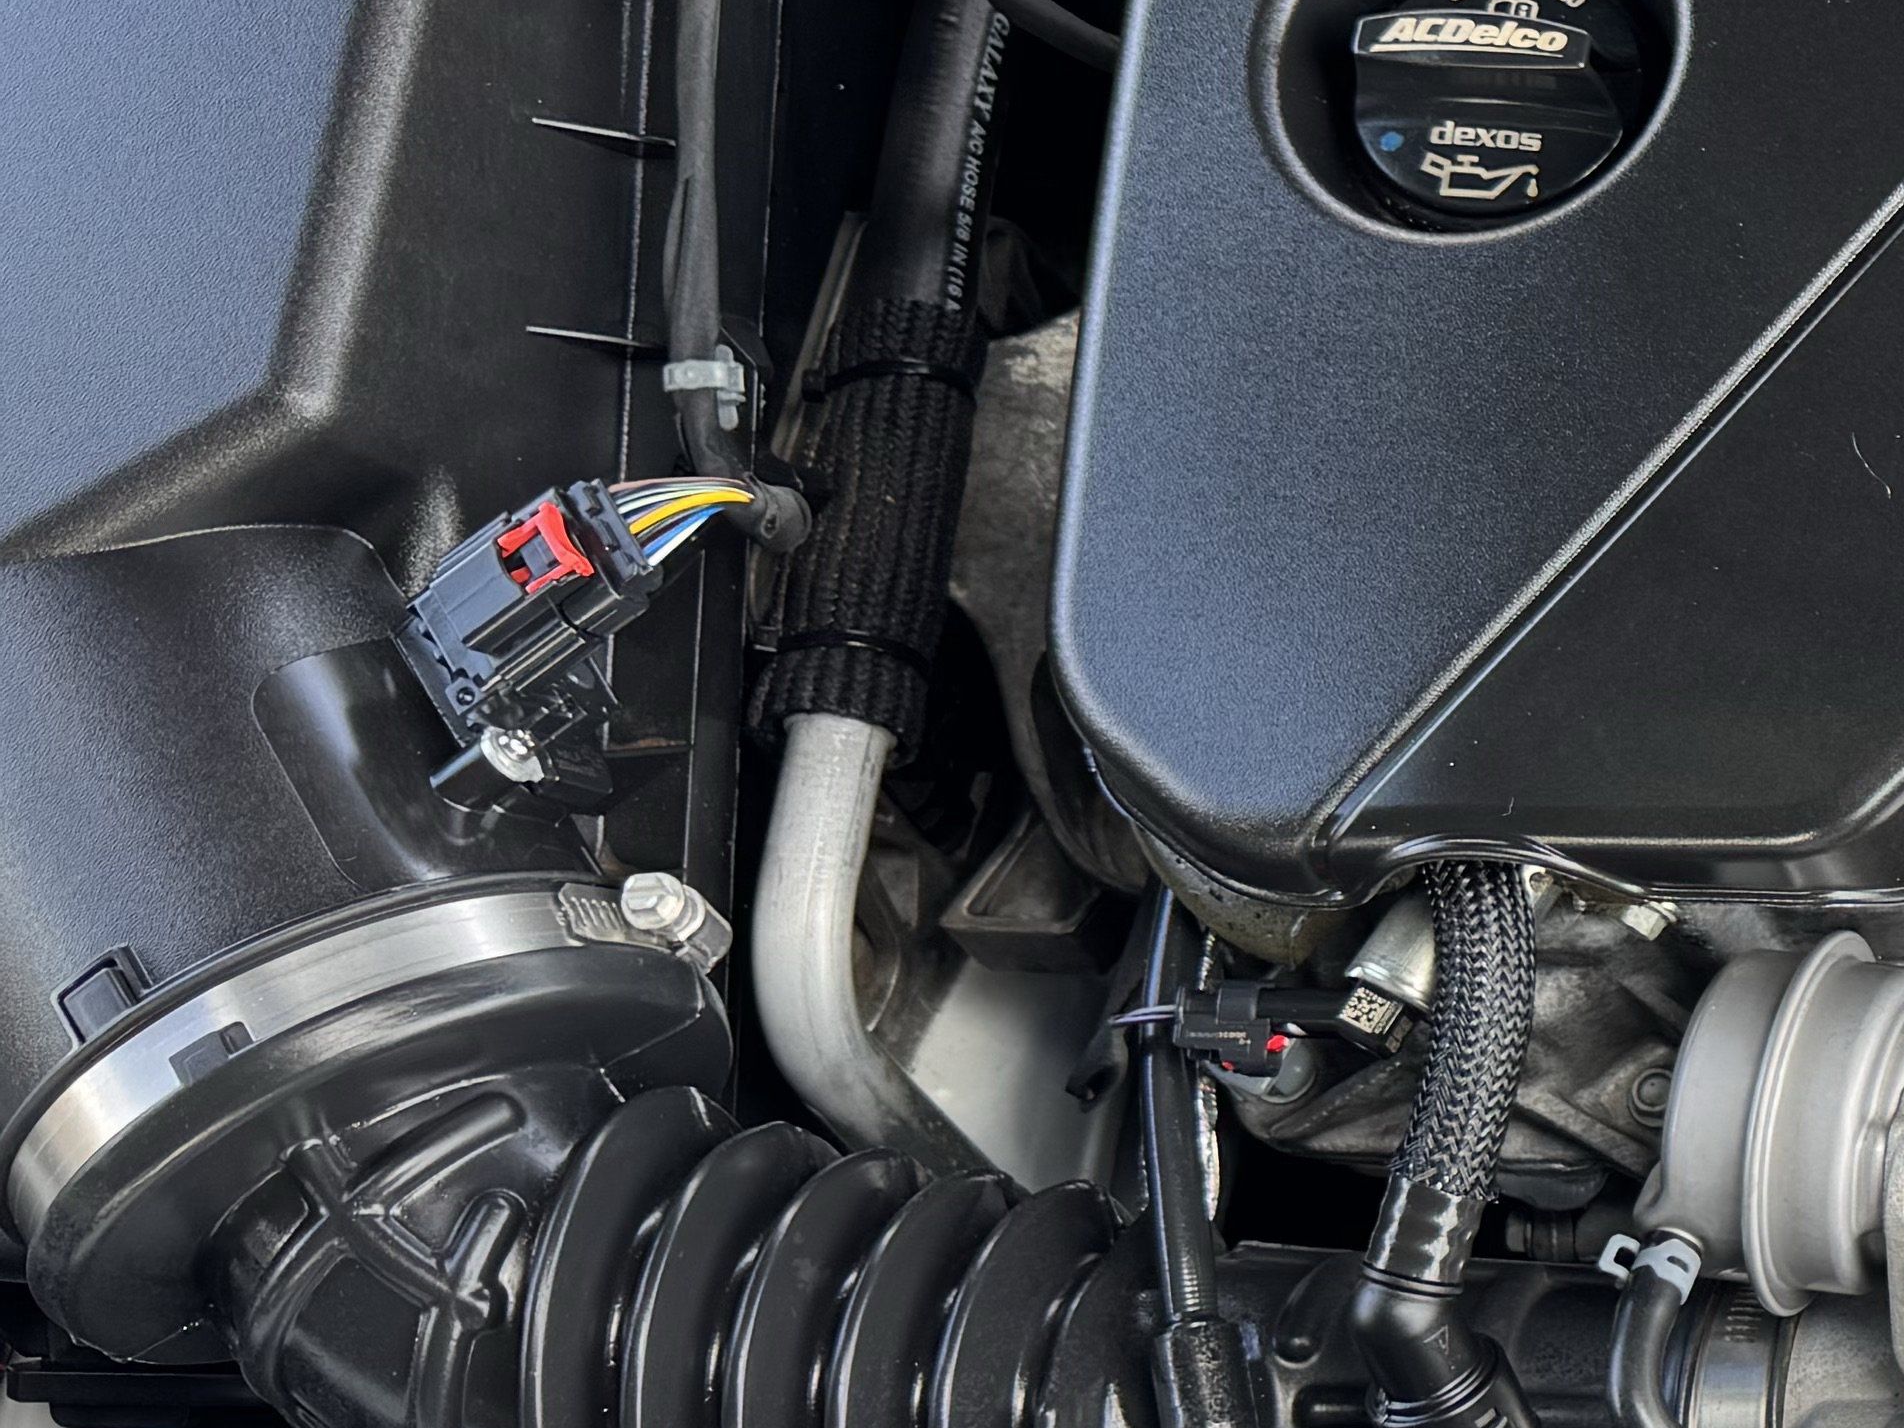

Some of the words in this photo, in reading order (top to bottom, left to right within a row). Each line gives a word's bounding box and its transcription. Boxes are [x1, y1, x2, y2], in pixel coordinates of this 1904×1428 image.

[1378, 17, 1568, 52] ACDelco
[974, 12, 1010, 122] GALAXY
[1430, 120, 1542, 151] dexos
[959, 154, 982, 211] HOSE
[951, 242, 969, 266] IN
